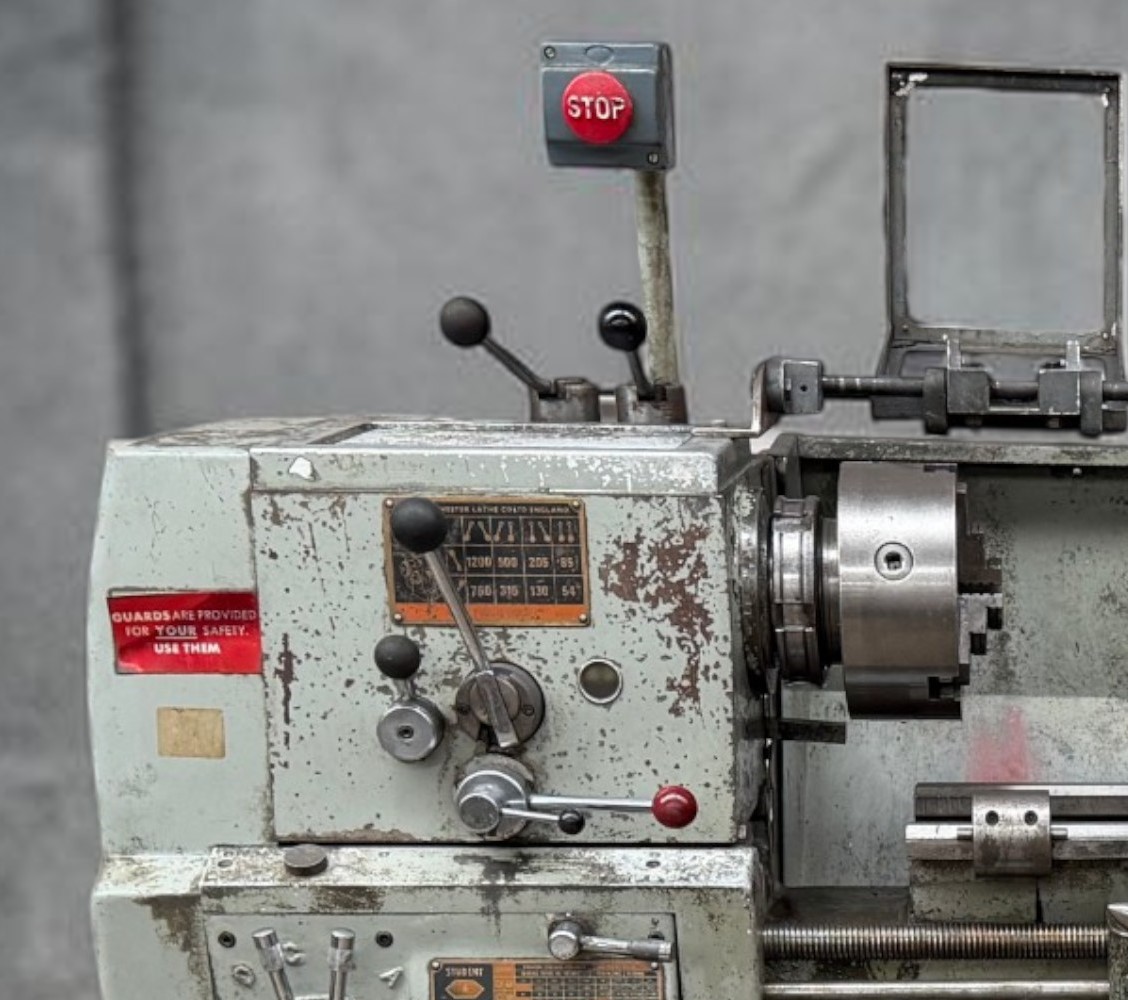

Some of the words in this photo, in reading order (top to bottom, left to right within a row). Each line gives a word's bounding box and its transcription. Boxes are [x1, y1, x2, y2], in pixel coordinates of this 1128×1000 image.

[567, 95, 626, 120] STOP
[528, 557, 549, 568] 205
[530, 585, 549, 597] 130
[562, 585, 576, 597] 54
[112, 611, 171, 623] GUARDS
[172, 610, 196, 620] ARE
[197, 610, 257, 620] PROVIDED
[125, 625, 149, 636] FOR
[155, 624, 197, 636] YOUR
[154, 642, 180, 654] USE
[182, 641, 221, 654] THEM
